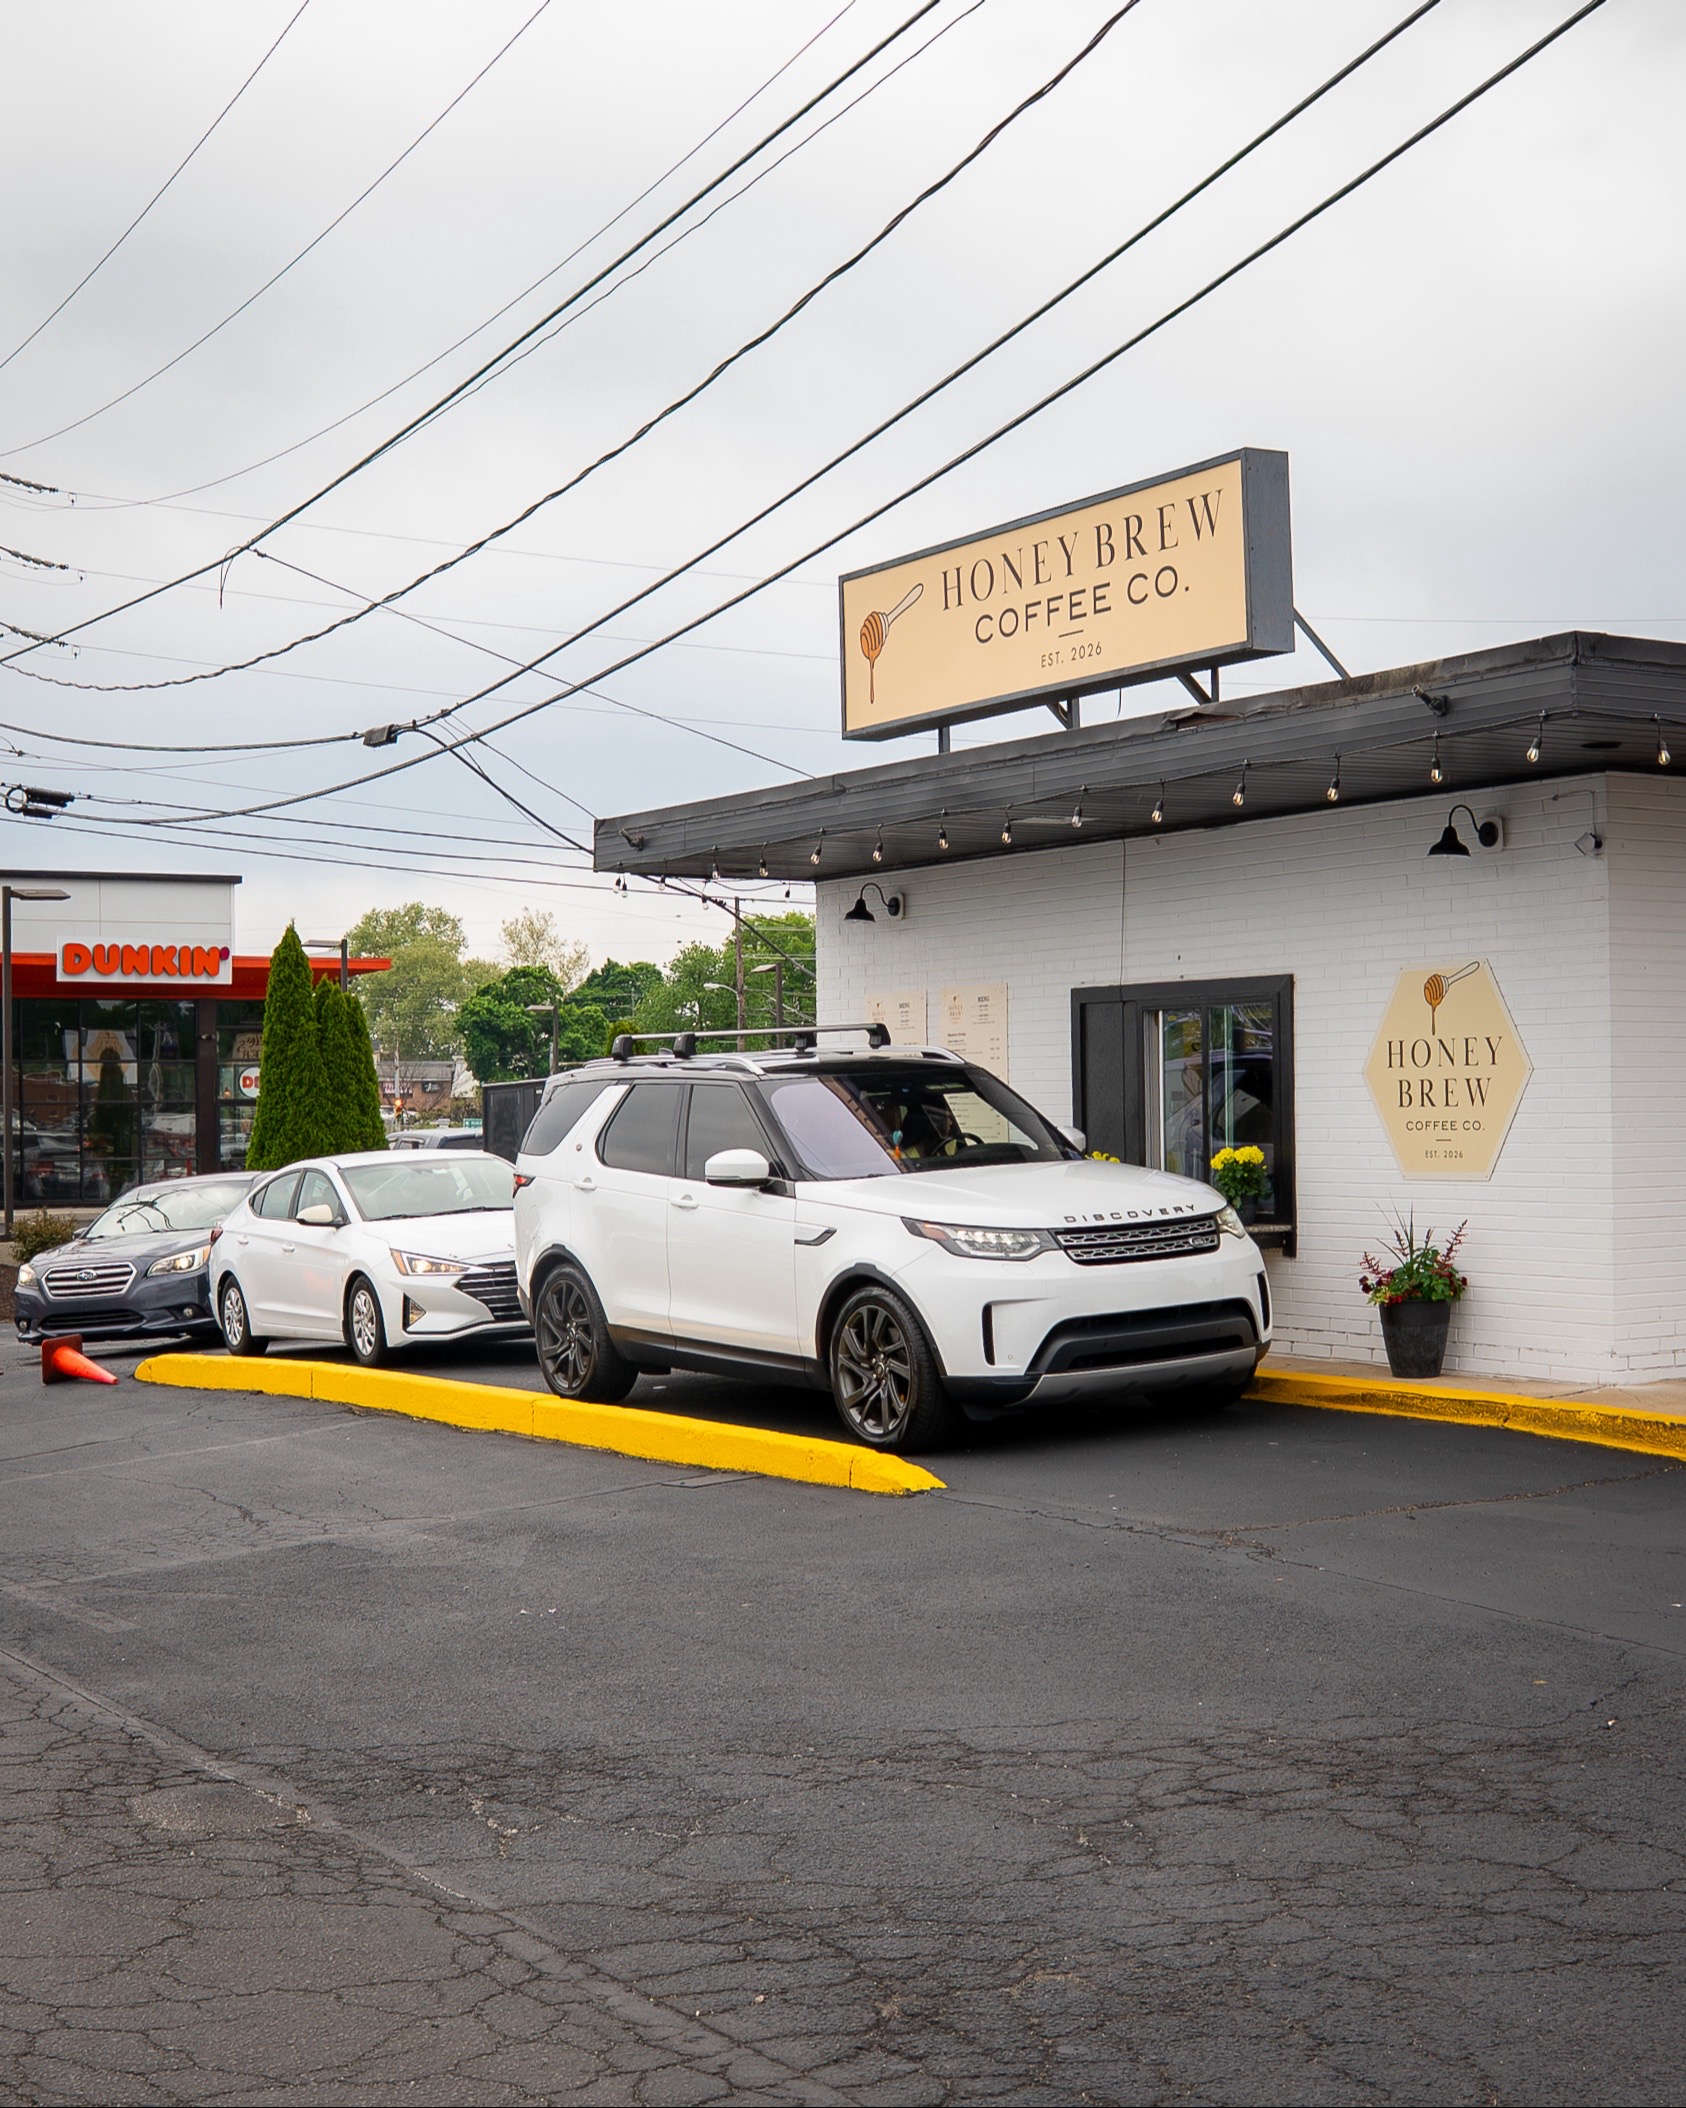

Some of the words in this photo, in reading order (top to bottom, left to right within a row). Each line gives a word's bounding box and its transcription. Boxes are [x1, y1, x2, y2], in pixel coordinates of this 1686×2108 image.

[941, 531, 1078, 611] HONEY
[1094, 488, 1224, 569] BREW
[975, 581, 1112, 644] COFFEE
[1126, 564, 1190, 604] CO.
[1040, 651, 1064, 669] EST.
[1070, 641, 1103, 664] 2026
[62, 943, 230, 977] DUNKIN'
[1387, 1035, 1503, 1069] HONEY
[1397, 1077, 1492, 1108] BREW
[1406, 1120, 1458, 1131] COFFEE
[1462, 1119, 1486, 1131] CO.
[1425, 1150, 1440, 1158] EST.
[1444, 1150, 1464, 1158] 2026
[1064, 1204, 1195, 1222] DISCOVERY
